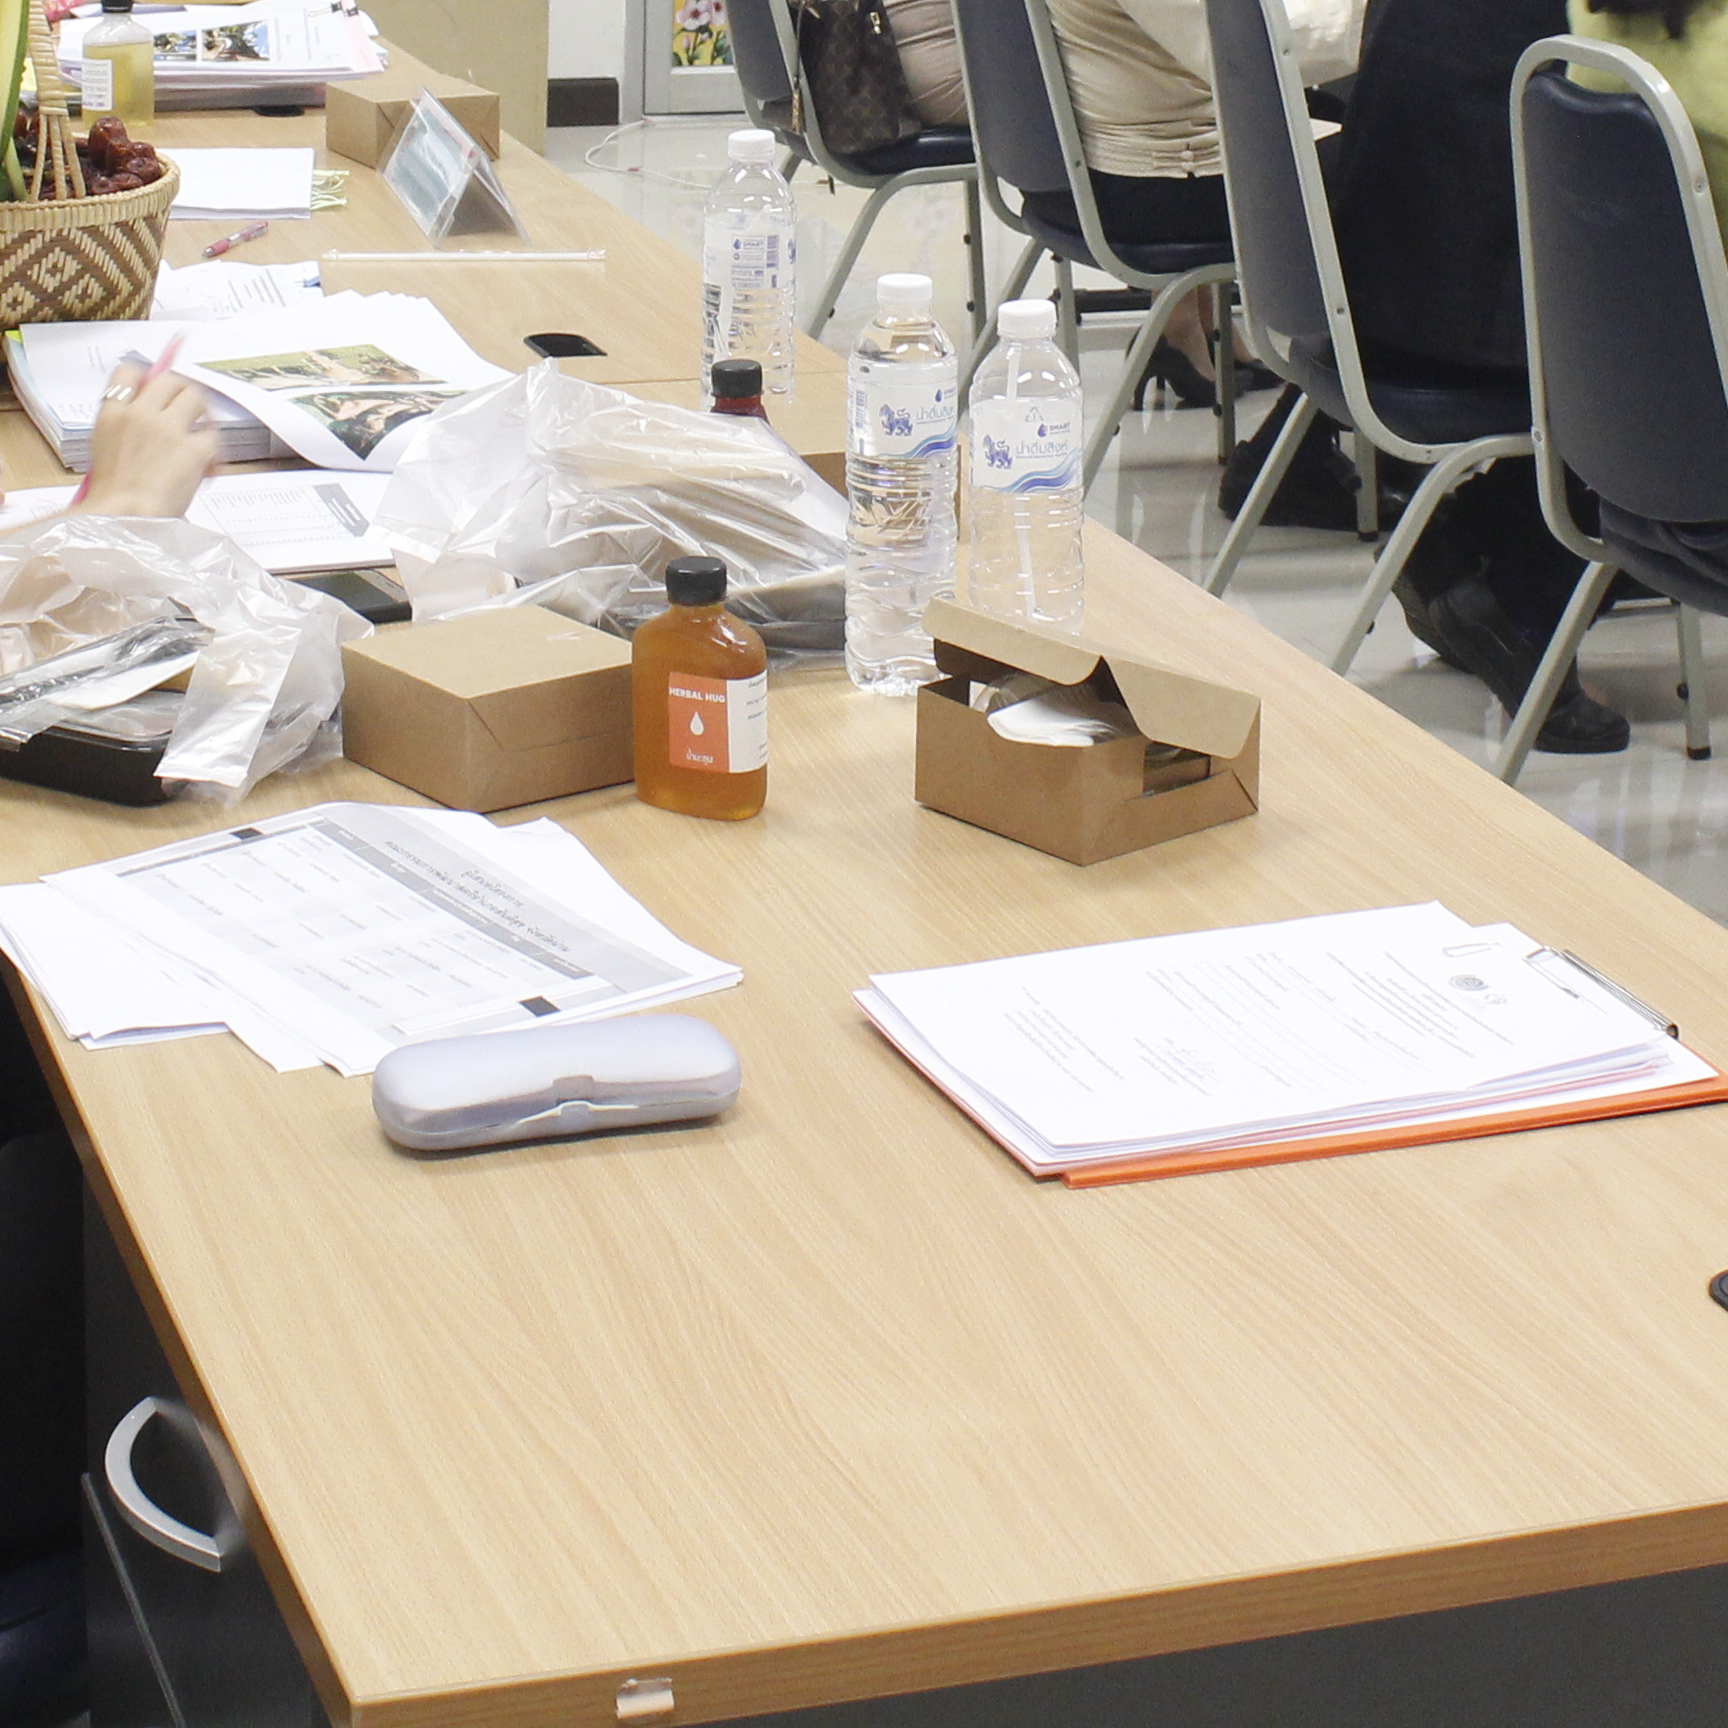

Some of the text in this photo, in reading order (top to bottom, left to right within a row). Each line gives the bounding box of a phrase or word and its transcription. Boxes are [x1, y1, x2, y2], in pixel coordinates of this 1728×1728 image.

[1049, 423, 1070, 431] SMART
[1016, 440, 1069, 455] น้ำดื่มสิงห์
[669, 686, 725, 703] HERBAL HUG
